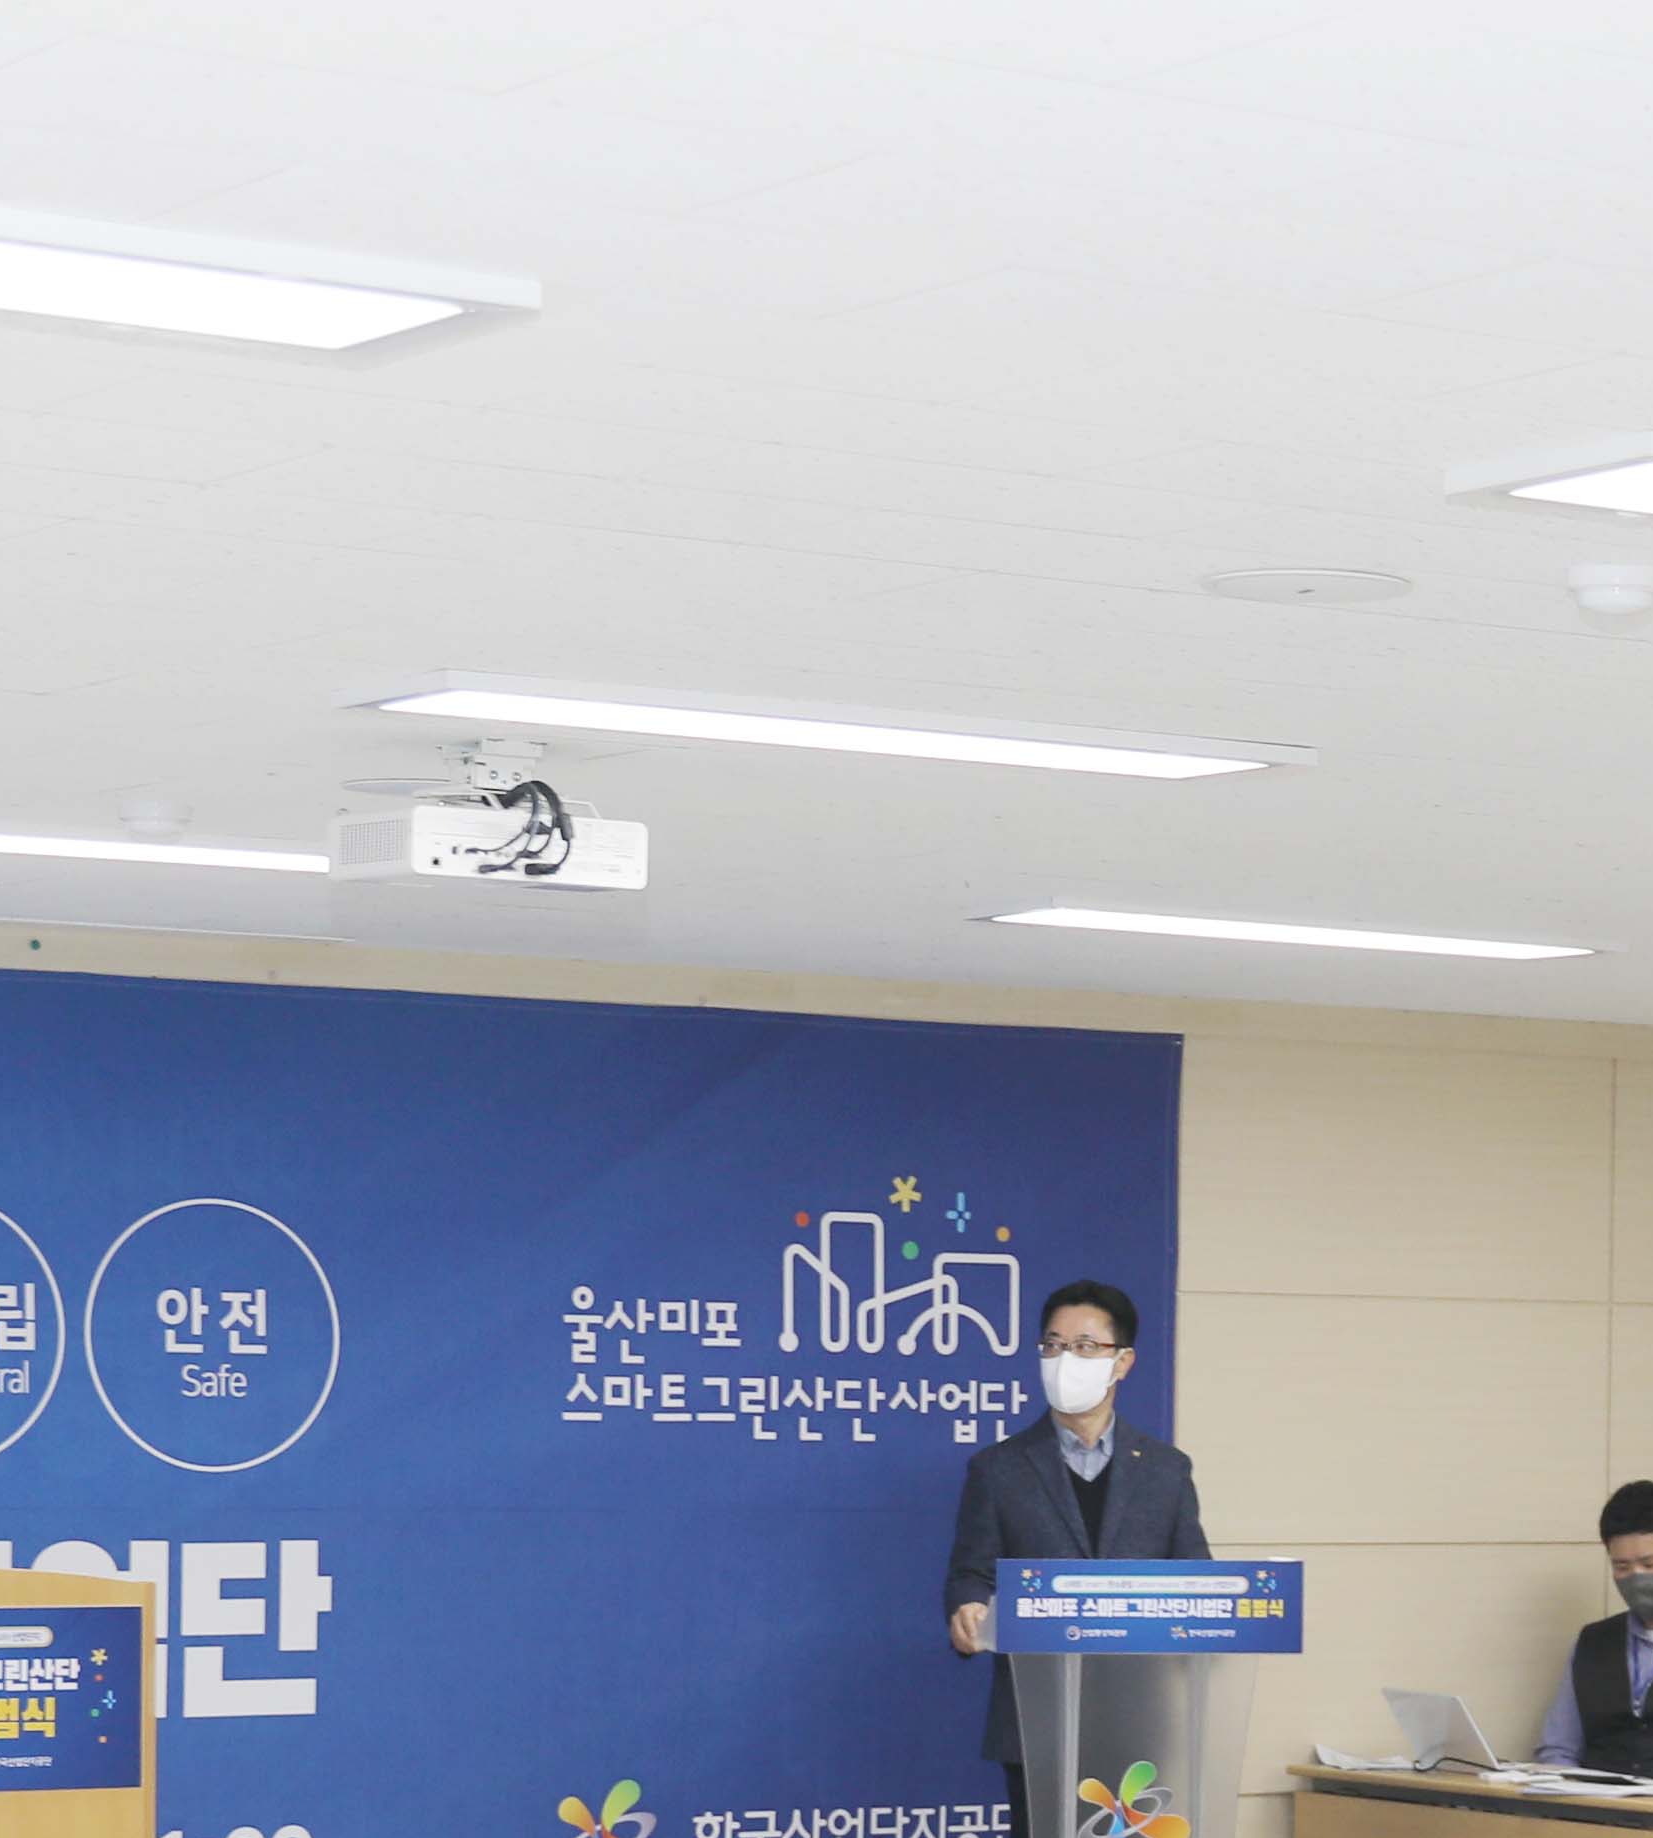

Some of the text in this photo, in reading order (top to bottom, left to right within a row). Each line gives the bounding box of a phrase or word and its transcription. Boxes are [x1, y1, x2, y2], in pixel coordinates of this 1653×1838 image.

[562, 1286, 742, 1364] 울산미포
[180, 1363, 248, 1398] Safe
[561, 1373, 1028, 1443] 스마트그린산단사업단
